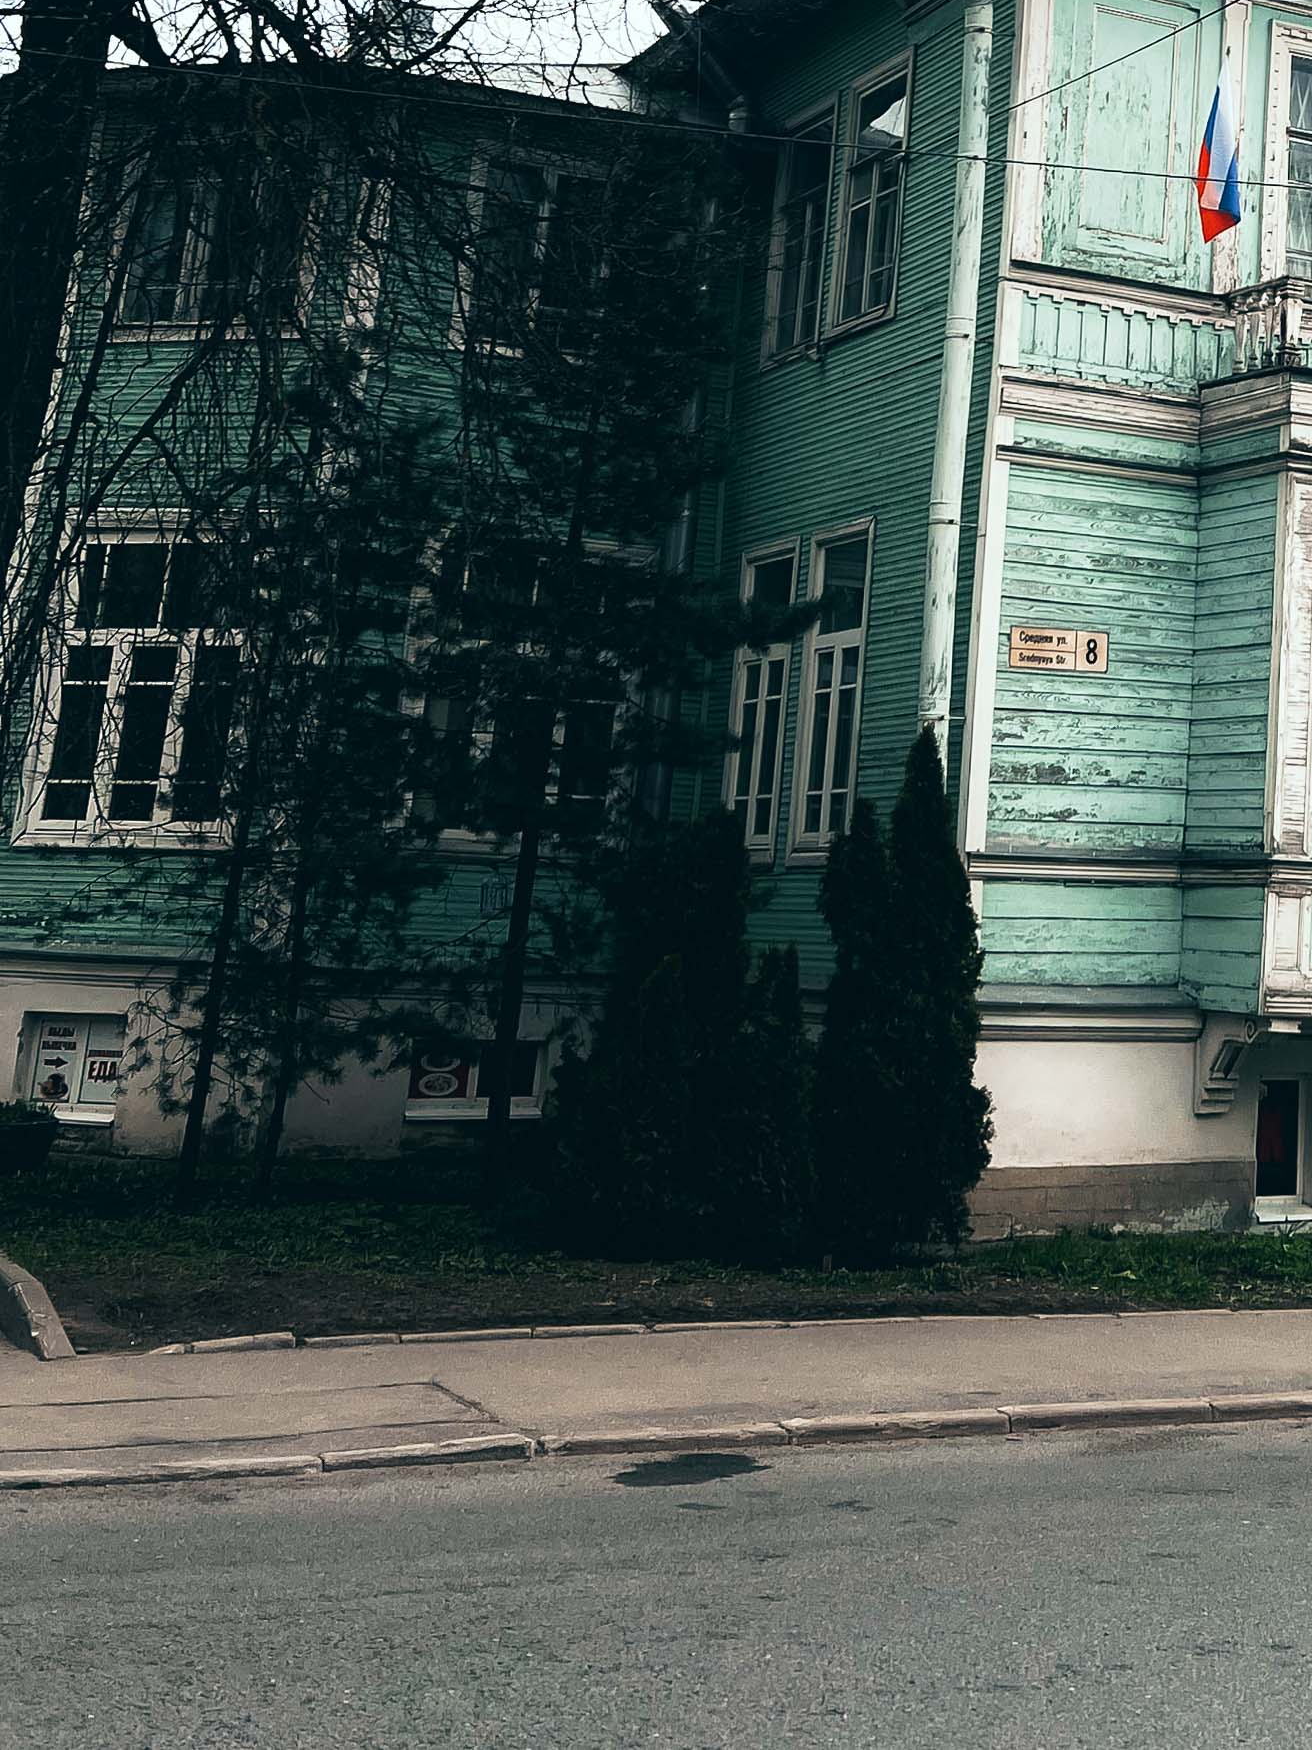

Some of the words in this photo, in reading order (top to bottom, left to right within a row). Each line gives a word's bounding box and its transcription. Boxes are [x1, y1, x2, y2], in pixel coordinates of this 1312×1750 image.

[1019, 631, 1053, 644] Средняя
[1057, 636, 1068, 646] ул.
[1086, 638, 1098, 665] 8
[87, 1060, 118, 1083] ЕДА
